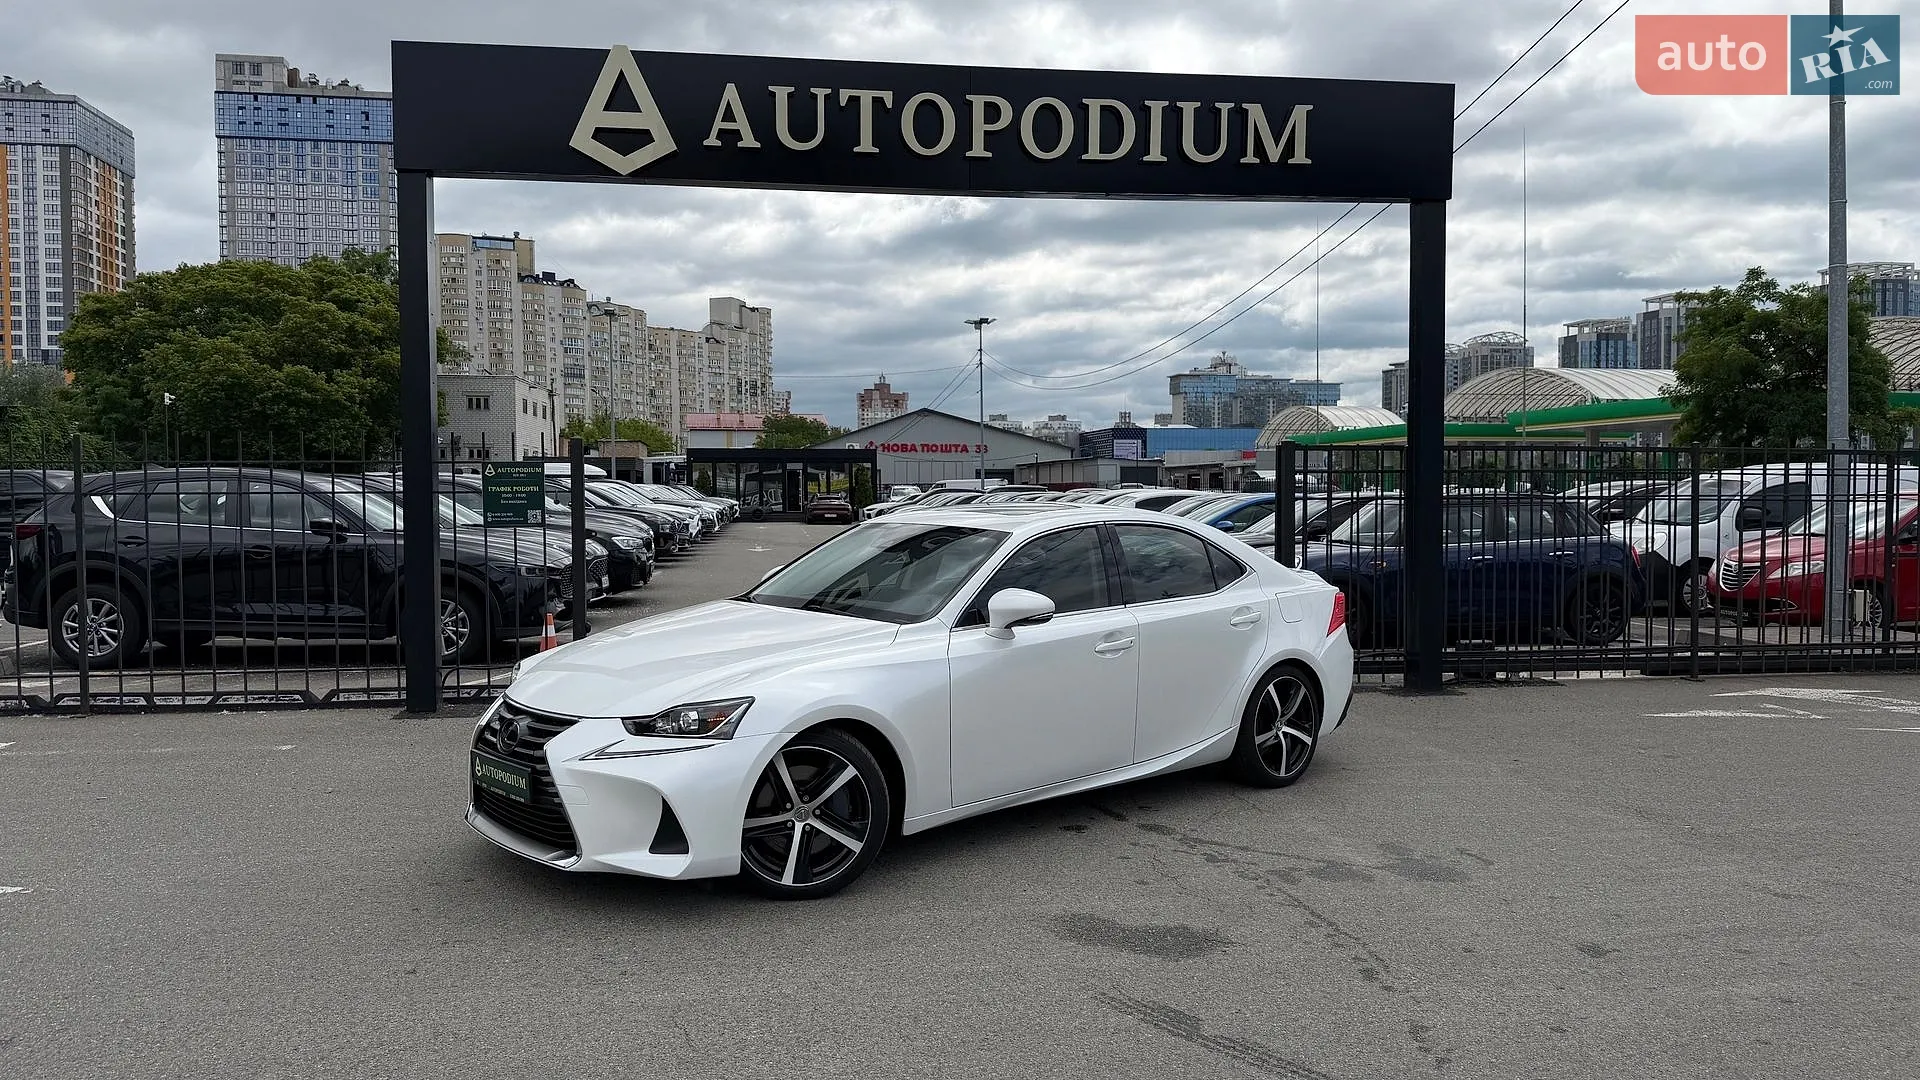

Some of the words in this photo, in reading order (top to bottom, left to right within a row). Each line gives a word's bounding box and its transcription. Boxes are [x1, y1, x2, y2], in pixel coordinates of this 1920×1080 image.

[703, 82, 1314, 166] AUTOPODIUM
[880, 443, 919, 453] НОВА
[920, 443, 970, 454] ПОШТА
[482, 764, 526, 789] AUTOPODIUM
